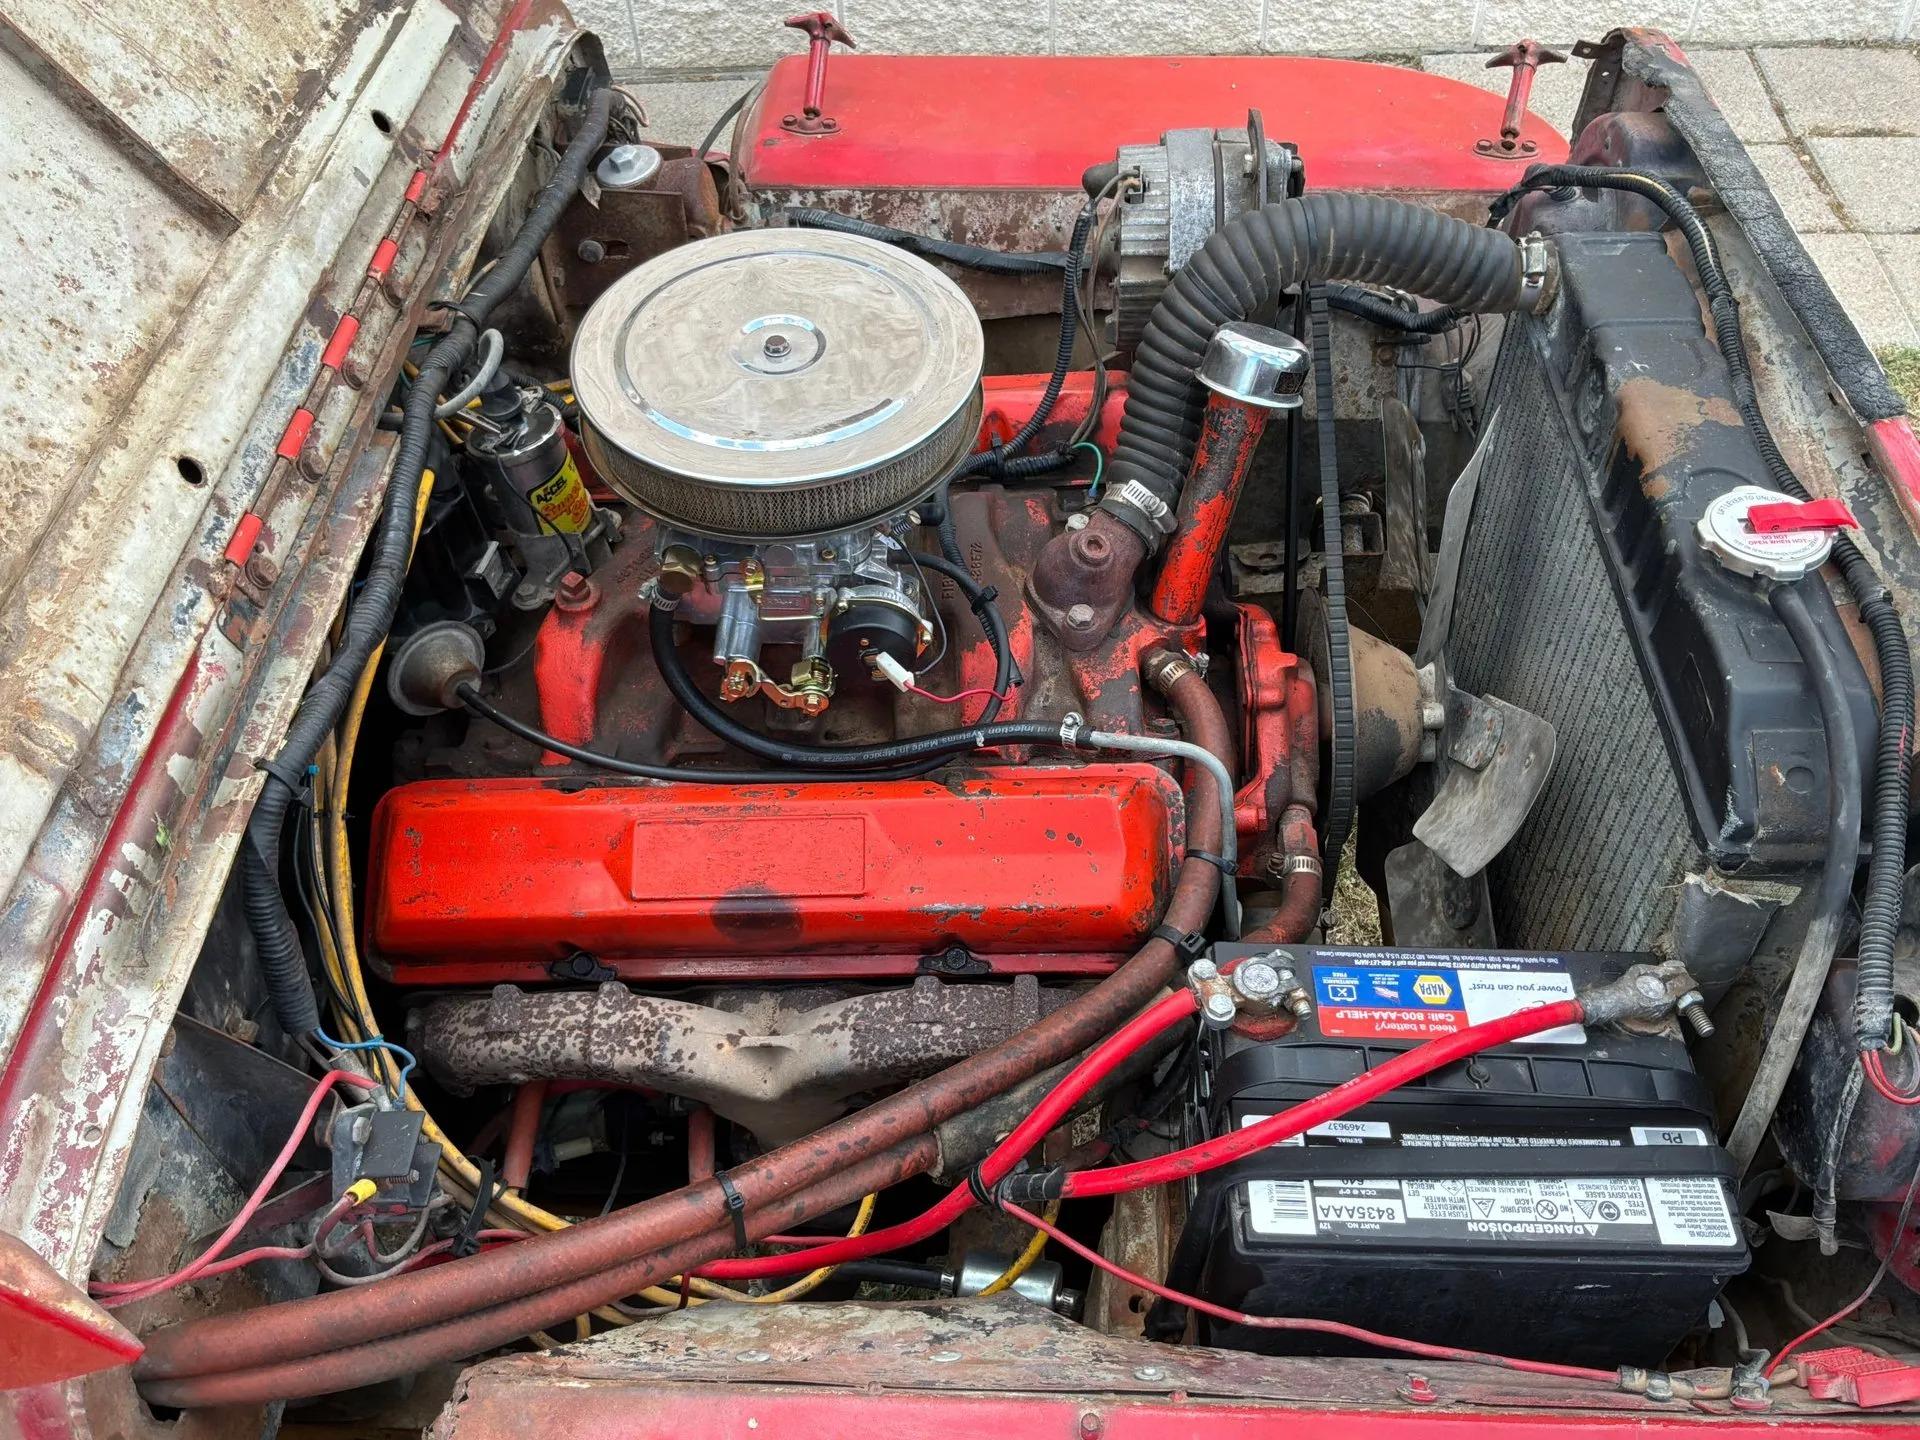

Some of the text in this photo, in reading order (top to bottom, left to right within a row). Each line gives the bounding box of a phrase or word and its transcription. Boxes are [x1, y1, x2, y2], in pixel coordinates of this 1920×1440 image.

[988, 724, 1035, 735] Injection
[899, 745, 909, 755] in
[912, 739, 939, 752] Made
[862, 749, 897, 761] Mexico
[1487, 962, 1501, 970] NAPA
[1418, 983, 1445, 997] NAPA
[1516, 981, 1535, 991] you
[1538, 985, 1568, 994] Power
[1335, 1010, 1455, 1022] Call: 800-AAA-HELP
[1375, 1021, 1417, 1032] battery?
[1429, 1024, 1457, 1034] Need
[1328, 1123, 1366, 1132] 2469637
[1493, 1136, 1515, 1144] FOLLOW
[1529, 1137, 1556, 1145] INVERTED
[1556, 1138, 1567, 1146] FOR
[1568, 1138, 1609, 1146] RECOMMENDED
[1662, 1132, 1683, 1144] Pb
[1405, 1182, 1435, 1190] MEDICAL
[1421, 1195, 1465, 1204] WITH WATER.
[1585, 1191, 1642, 1199] EXPLOSIVE GASES
[1514, 1198, 1530, 1206] ACID
[1625, 1200, 1645, 1208] EYES.
[1423, 1203, 1466, 1211] IMMEDIATELY
[1499, 1205, 1532, 1214] SULFURIC
[1559, 1204, 1569, 1212] NO
[1319, 1205, 1395, 1221] 8435AAA
[1448, 1210, 1469, 1218] FLUSH
[1624, 1208, 1647, 1217] SHIELD
[1361, 1222, 1380, 1230] PART
[1467, 1221, 1585, 1235] DANGER/POISON
